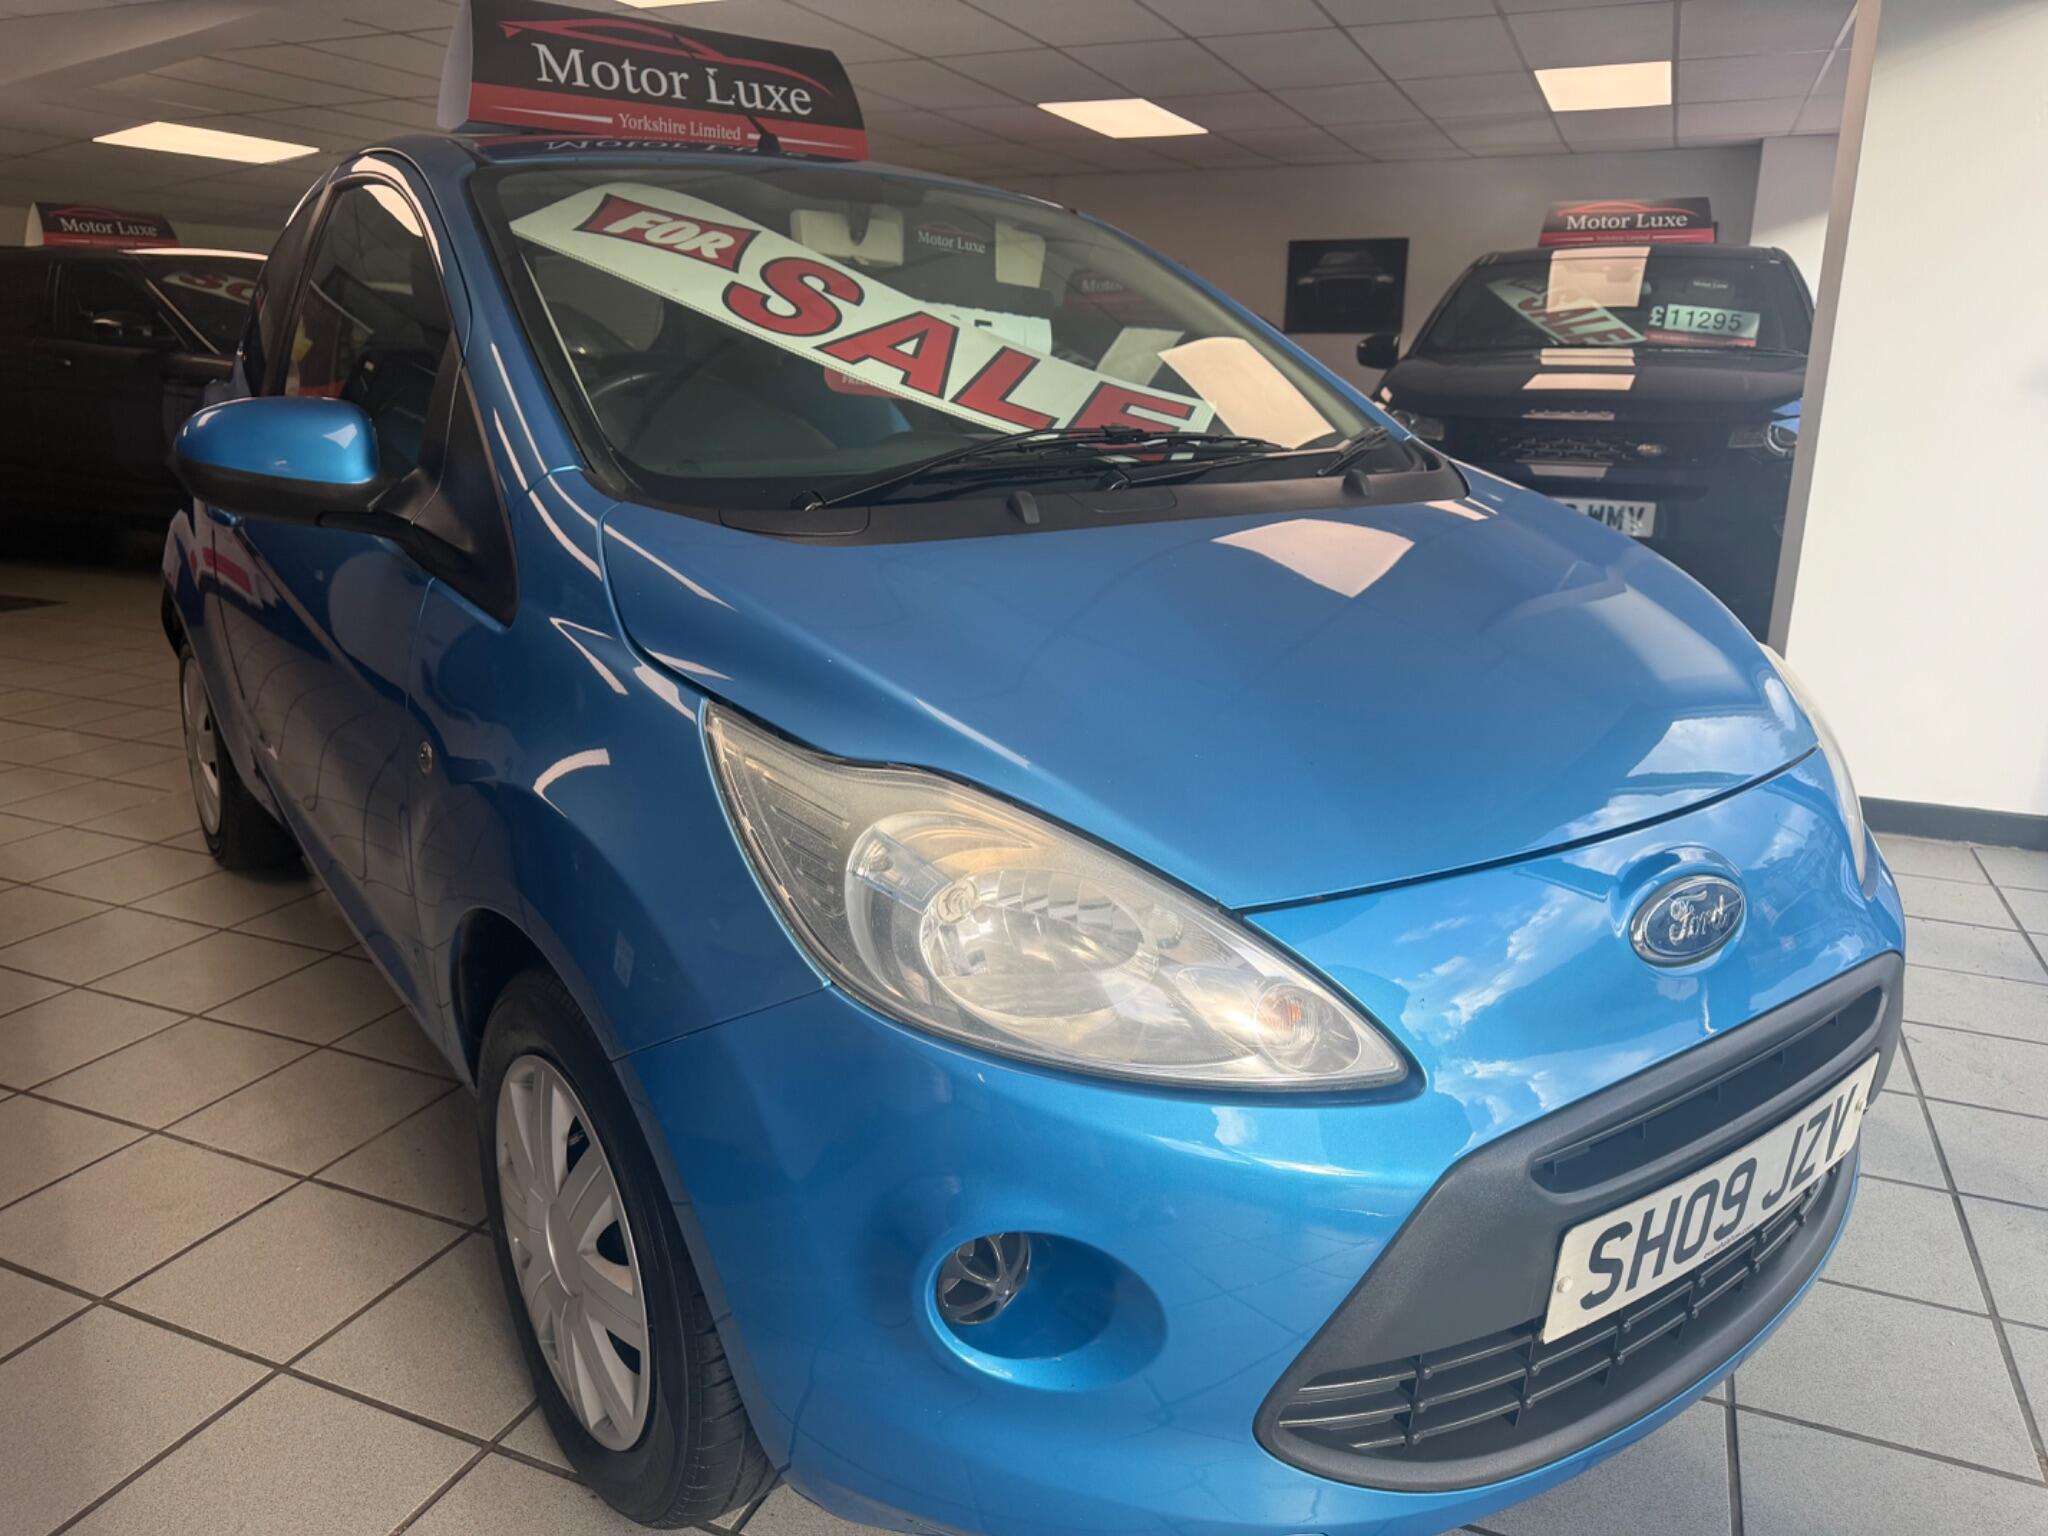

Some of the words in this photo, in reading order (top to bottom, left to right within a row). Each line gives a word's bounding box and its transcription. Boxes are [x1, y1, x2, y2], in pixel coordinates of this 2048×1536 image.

[531, 43, 689, 100] Motor
[705, 67, 812, 115] Luxe
[618, 113, 686, 135] Yorkshire
[690, 121, 741, 141] Limited
[60, 217, 113, 234] Motor
[116, 221, 157, 237] Luxe
[602, 210, 735, 260] FOR
[918, 230, 954, 248] Motor
[957, 237, 986, 254] Luxe
[1566, 214, 1630, 230] Motor
[1636, 213, 1688, 228] Luxe
[721, 256, 1197, 461] SALE
[1668, 890, 1728, 946] Ford
[1580, 1157, 1757, 1310] SH09
[1762, 1085, 1859, 1210] JZV
